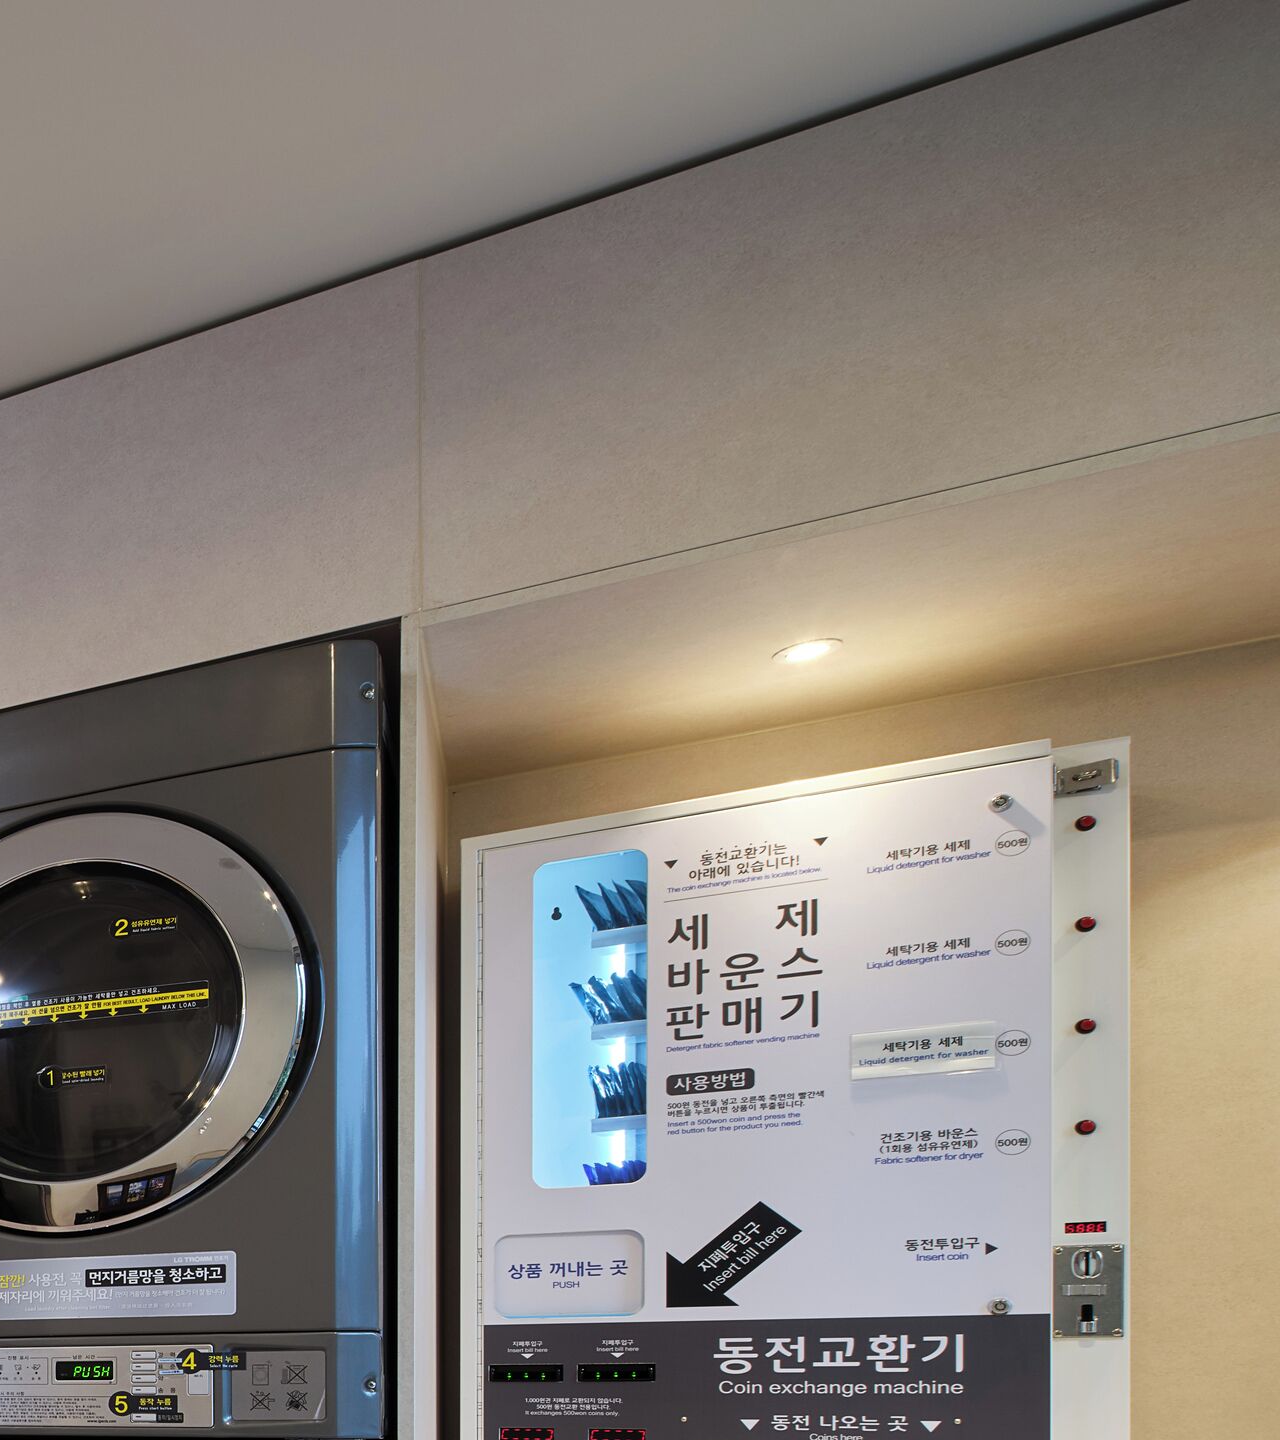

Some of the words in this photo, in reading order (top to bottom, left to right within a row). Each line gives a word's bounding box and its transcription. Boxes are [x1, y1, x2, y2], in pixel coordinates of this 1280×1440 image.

[885, 844, 939, 860] 세탁기용
[943, 839, 971, 852] 세제
[997, 837, 1028, 848] 500원
[700, 843, 788, 866] 동전교환기는
[866, 864, 894, 874] Liquid
[895, 858, 940, 871] detergent
[941, 855, 954, 864] for
[955, 851, 991, 861] washer
[688, 865, 730, 881] 아래에
[736, 855, 800, 875] 있습니다!
[697, 879, 731, 890] exchange
[732, 875, 763, 884] machine
[771, 869, 798, 878] located
[114, 918, 129, 937] 2
[885, 941, 939, 957] 세탁기용
[943, 936, 971, 950] 세제
[997, 937, 1028, 948] 500원
[866, 960, 894, 970] Liquid
[895, 955, 940, 967] detergent
[941, 952, 954, 961] for
[955, 949, 991, 959] washer
[178, 1001, 197, 1009] LOAD
[666, 1043, 702, 1053] Detergent
[702, 1041, 723, 1050] fabric
[724, 1038, 754, 1048] softener
[755, 1035, 786, 1045] vending
[787, 1032, 820, 1041] machine
[882, 1038, 932, 1053] 세탁기용
[938, 1035, 964, 1048] 세제
[997, 1038, 1028, 1048] 500원
[859, 1057, 886, 1067] Liquid
[889, 1053, 935, 1064] detergent
[937, 1051, 952, 1059] for
[954, 1048, 989, 1058] washer
[673, 1071, 746, 1092] 사용방법
[764, 1114, 786, 1122] press
[681, 1127, 705, 1135] button
[719, 1124, 732, 1132] the
[733, 1122, 763, 1131] product
[764, 1121, 779, 1129] you
[880, 1130, 932, 1145] 건조기용
[937, 1127, 979, 1140] 바운스
[879, 1142, 912, 1154] (1회용
[917, 1139, 979, 1152] 섬유유연제)
[997, 1137, 1028, 1147] 500원
[874, 1156, 903, 1165] Fabric
[905, 1153, 943, 1163] softener
[944, 1152, 956, 1161] for
[957, 1151, 984, 1162] dryer
[697, 1220, 762, 1273] 지폐투입구
[904, 1236, 980, 1252] 동전투입구
[702, 1263, 742, 1293] Insert
[737, 1247, 760, 1268] bill
[757, 1224, 788, 1251] here
[916, 1252, 945, 1262] Insert
[947, 1251, 969, 1261] coin
[89, 1268, 166, 1286] 먼지거름망을
[168, 1267, 223, 1284] 청소하고
[507, 1262, 543, 1280] 상품
[549, 1259, 604, 1278] 꺼내는
[609, 1259, 629, 1277] 곳
[552, 1280, 581, 1290] PUSH
[48, 1287, 113, 1304] 끼워주세요!
[181, 1351, 197, 1370] 4
[208, 1355, 223, 1364] 강력
[225, 1355, 240, 1364] 누름
[713, 1333, 965, 1375] 동전교환기
[73, 1365, 111, 1378] PUSH
[718, 1379, 763, 1395] Coin
[769, 1380, 868, 1397] exchange
[874, 1380, 964, 1395] machine
[114, 1395, 128, 1414] 5
[139, 1398, 154, 1407] 동작
[157, 1398, 171, 1406] 누름
[770, 1414, 811, 1431] 동전
[819, 1415, 881, 1432] 나오는
[887, 1416, 910, 1432] 곳
